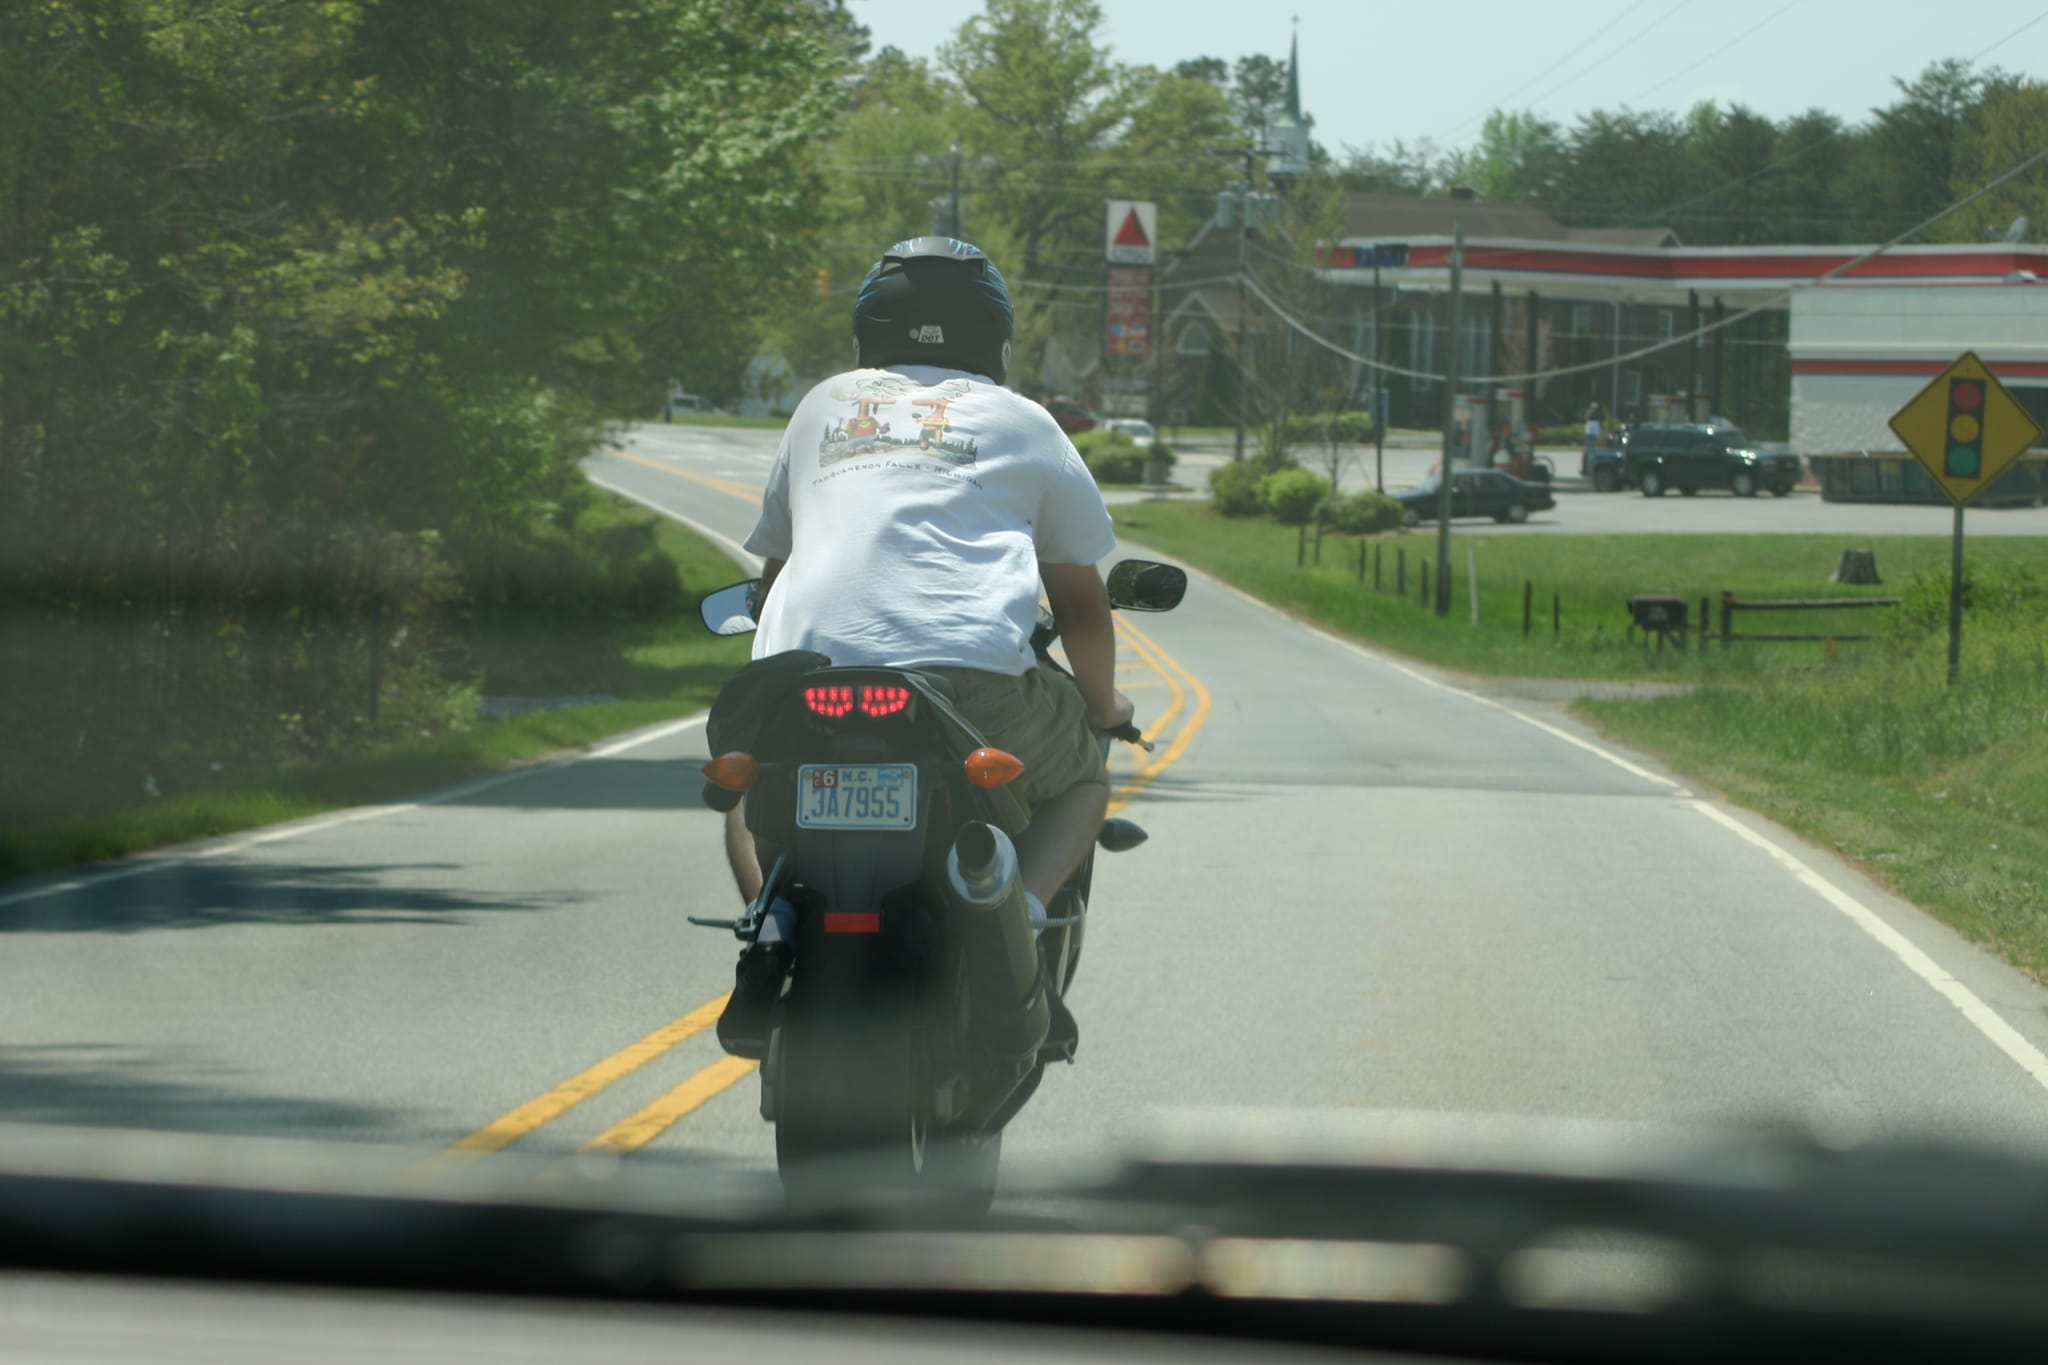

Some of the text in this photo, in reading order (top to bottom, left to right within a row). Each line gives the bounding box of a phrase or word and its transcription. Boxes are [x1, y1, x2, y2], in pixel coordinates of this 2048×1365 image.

[885, 460, 921, 471] FALLS
[823, 770, 835, 786] 6
[841, 770, 872, 783] N.C.
[811, 786, 900, 818] 3A7955
